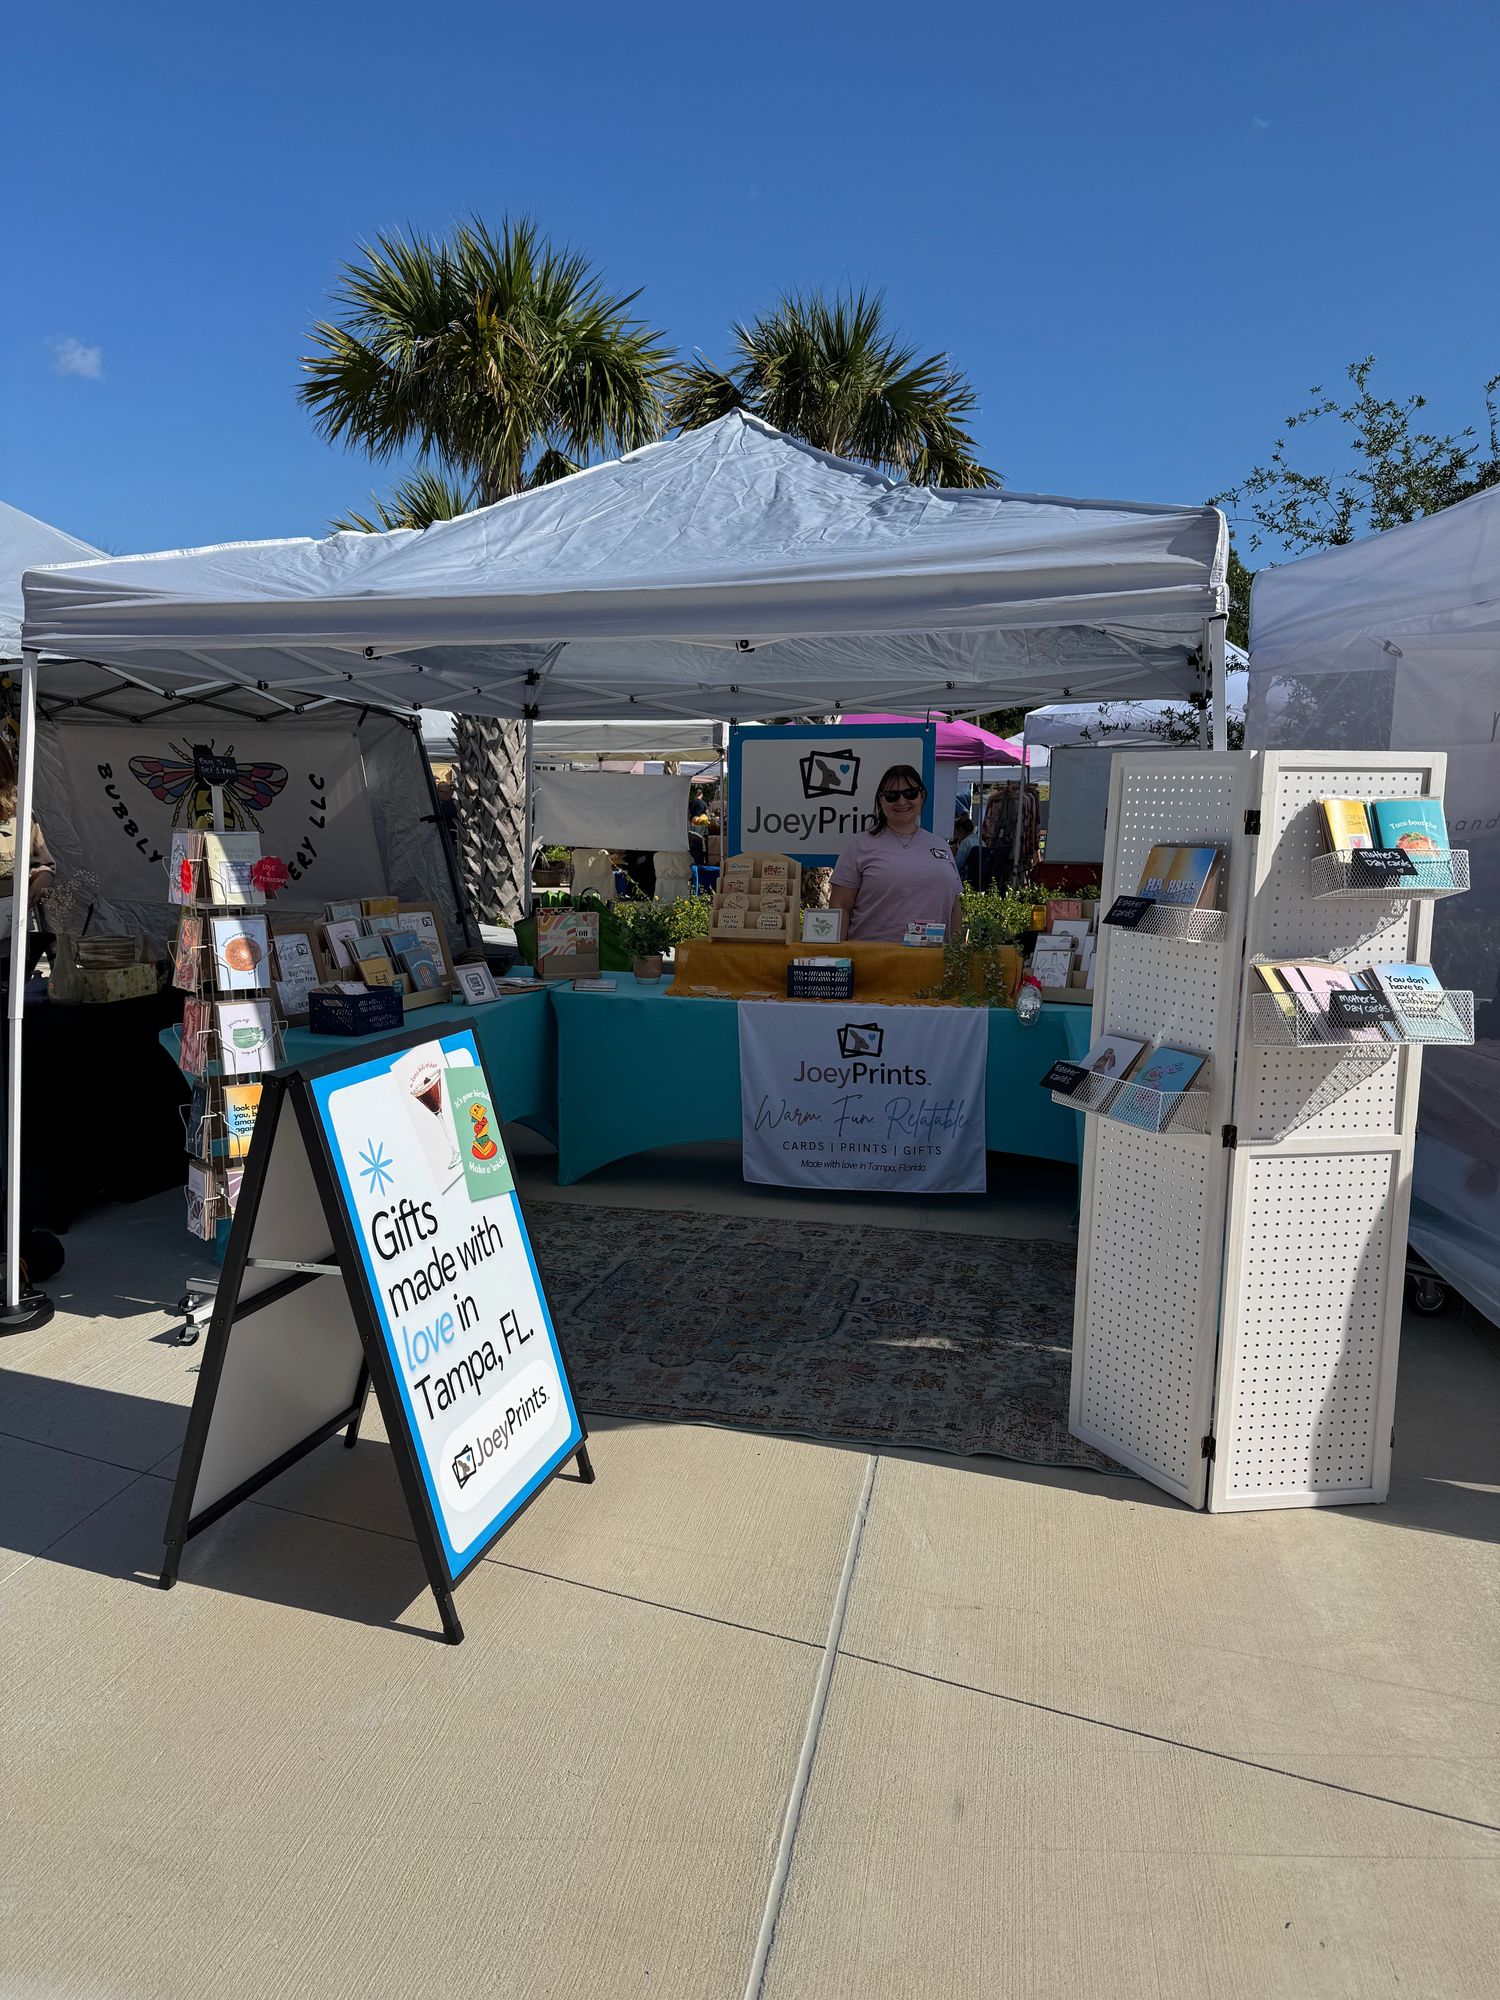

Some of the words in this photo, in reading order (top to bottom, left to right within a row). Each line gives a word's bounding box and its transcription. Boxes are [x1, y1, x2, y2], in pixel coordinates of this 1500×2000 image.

[97, 763, 165, 863] BUBBLY
[287, 836, 318, 881] ERY
[308, 773, 327, 829] LLC
[747, 806, 881, 840] JoeyPrin
[1389, 821, 1408, 830] Taco
[1408, 819, 1426, 827] bout
[1359, 850, 1401, 860] Mother's
[1364, 859, 1386, 869] Day
[1387, 859, 1412, 868] cards
[1117, 898, 1146, 908] Easter
[1386, 975, 1405, 984] You
[1406, 976, 1430, 984] don't
[1390, 983, 1414, 991] have
[1338, 994, 1377, 1004] Mother's
[1343, 1004, 1363, 1015] Day
[1364, 1003, 1391, 1013] cards
[1055, 1064, 1080, 1076] Easter
[233, 1103, 250, 1112] look
[755, 1094, 823, 1131] Warm.
[832, 1094, 874, 1138] Fun.
[783, 1141, 825, 1151] CARDS
[841, 1143, 888, 1154] PRINTS
[904, 1145, 942, 1155] GIFTS
[800, 1159, 823, 1168] Made
[824, 1159, 841, 1168] with
[841, 1160, 858, 1169] love
[859, 1161, 866, 1170] in
[868, 1162, 897, 1172] Tampa,
[898, 1163, 926, 1172] Florida
[371, 1198, 439, 1261] Gifts
[388, 1246, 457, 1318] made
[457, 1216, 504, 1272] with
[402, 1312, 455, 1371] love
[453, 1293, 480, 1332] in
[414, 1341, 504, 1420] Tampa,
[500, 1309, 535, 1356] FL.
